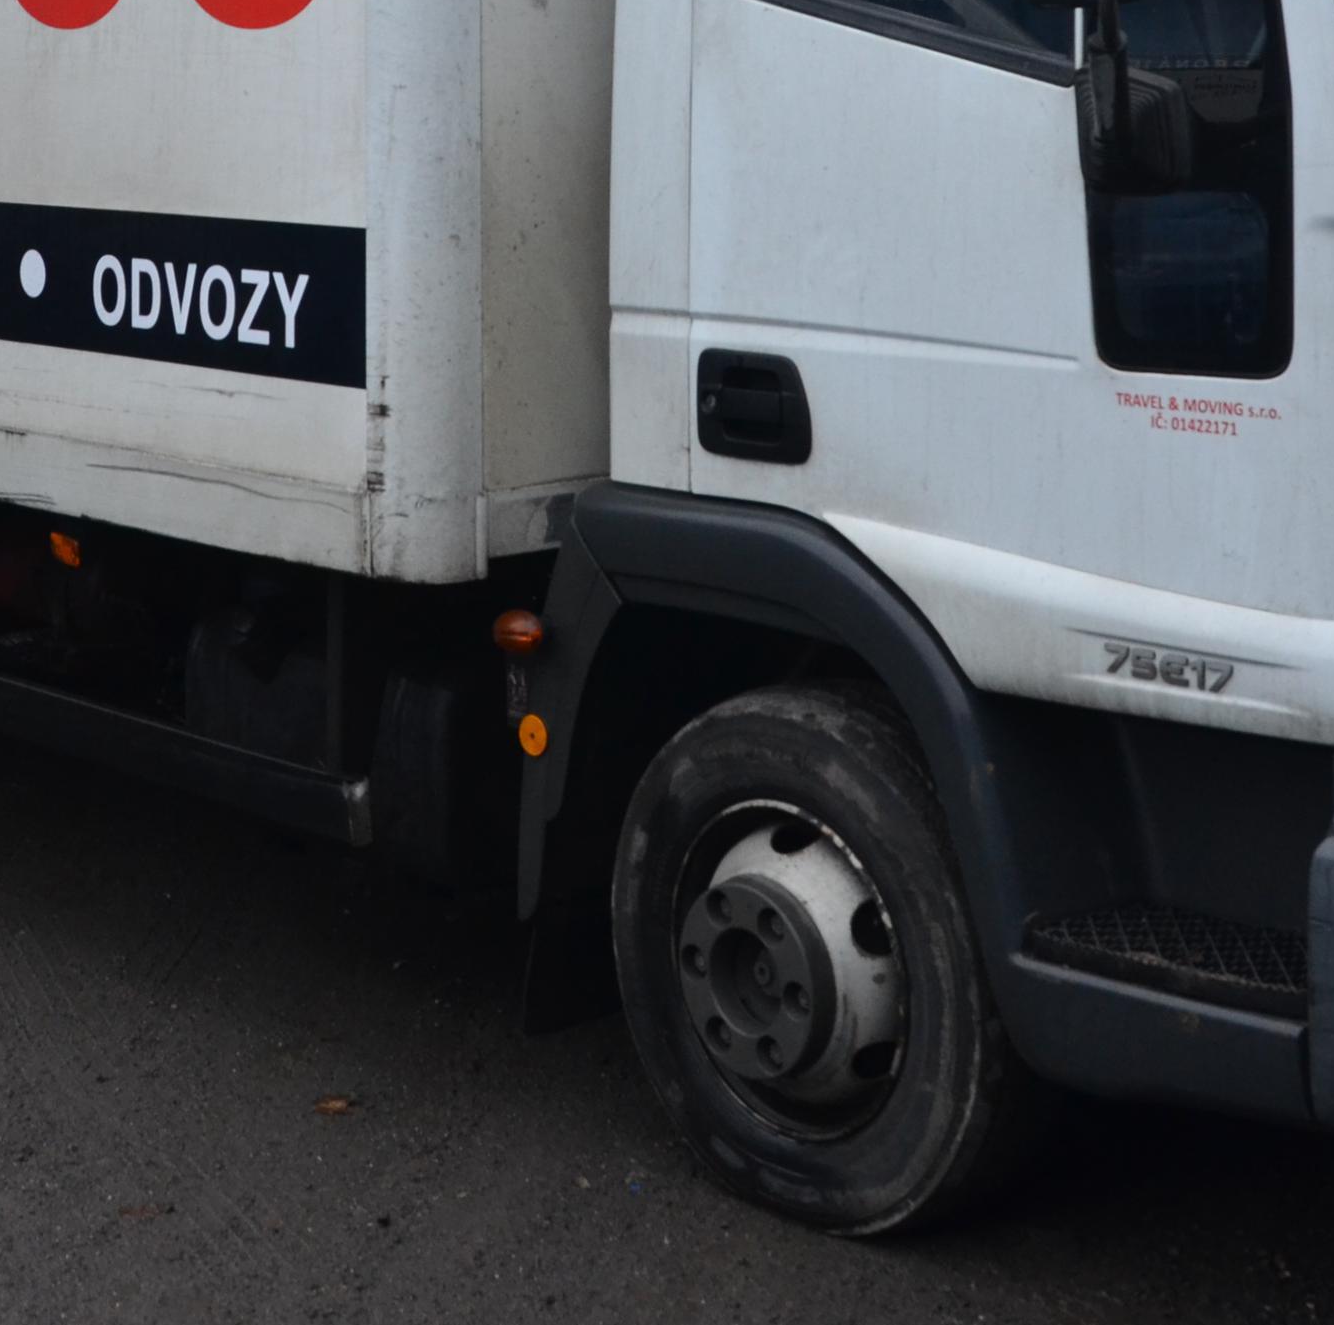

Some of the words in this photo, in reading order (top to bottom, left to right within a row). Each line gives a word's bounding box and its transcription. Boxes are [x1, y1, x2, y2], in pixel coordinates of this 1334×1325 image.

[92, 253, 310, 349] ODVOZY
[1116, 392, 1164, 411] TRAVEL
[1168, 396, 1179, 411] &
[1183, 398, 1244, 417] MOVING
[1248, 406, 1282, 420] s.r.o.
[1151, 412, 1168, 430] IČ:
[1171, 417, 1238, 436] 01422171
[1103, 641, 1235, 694] 75E17
